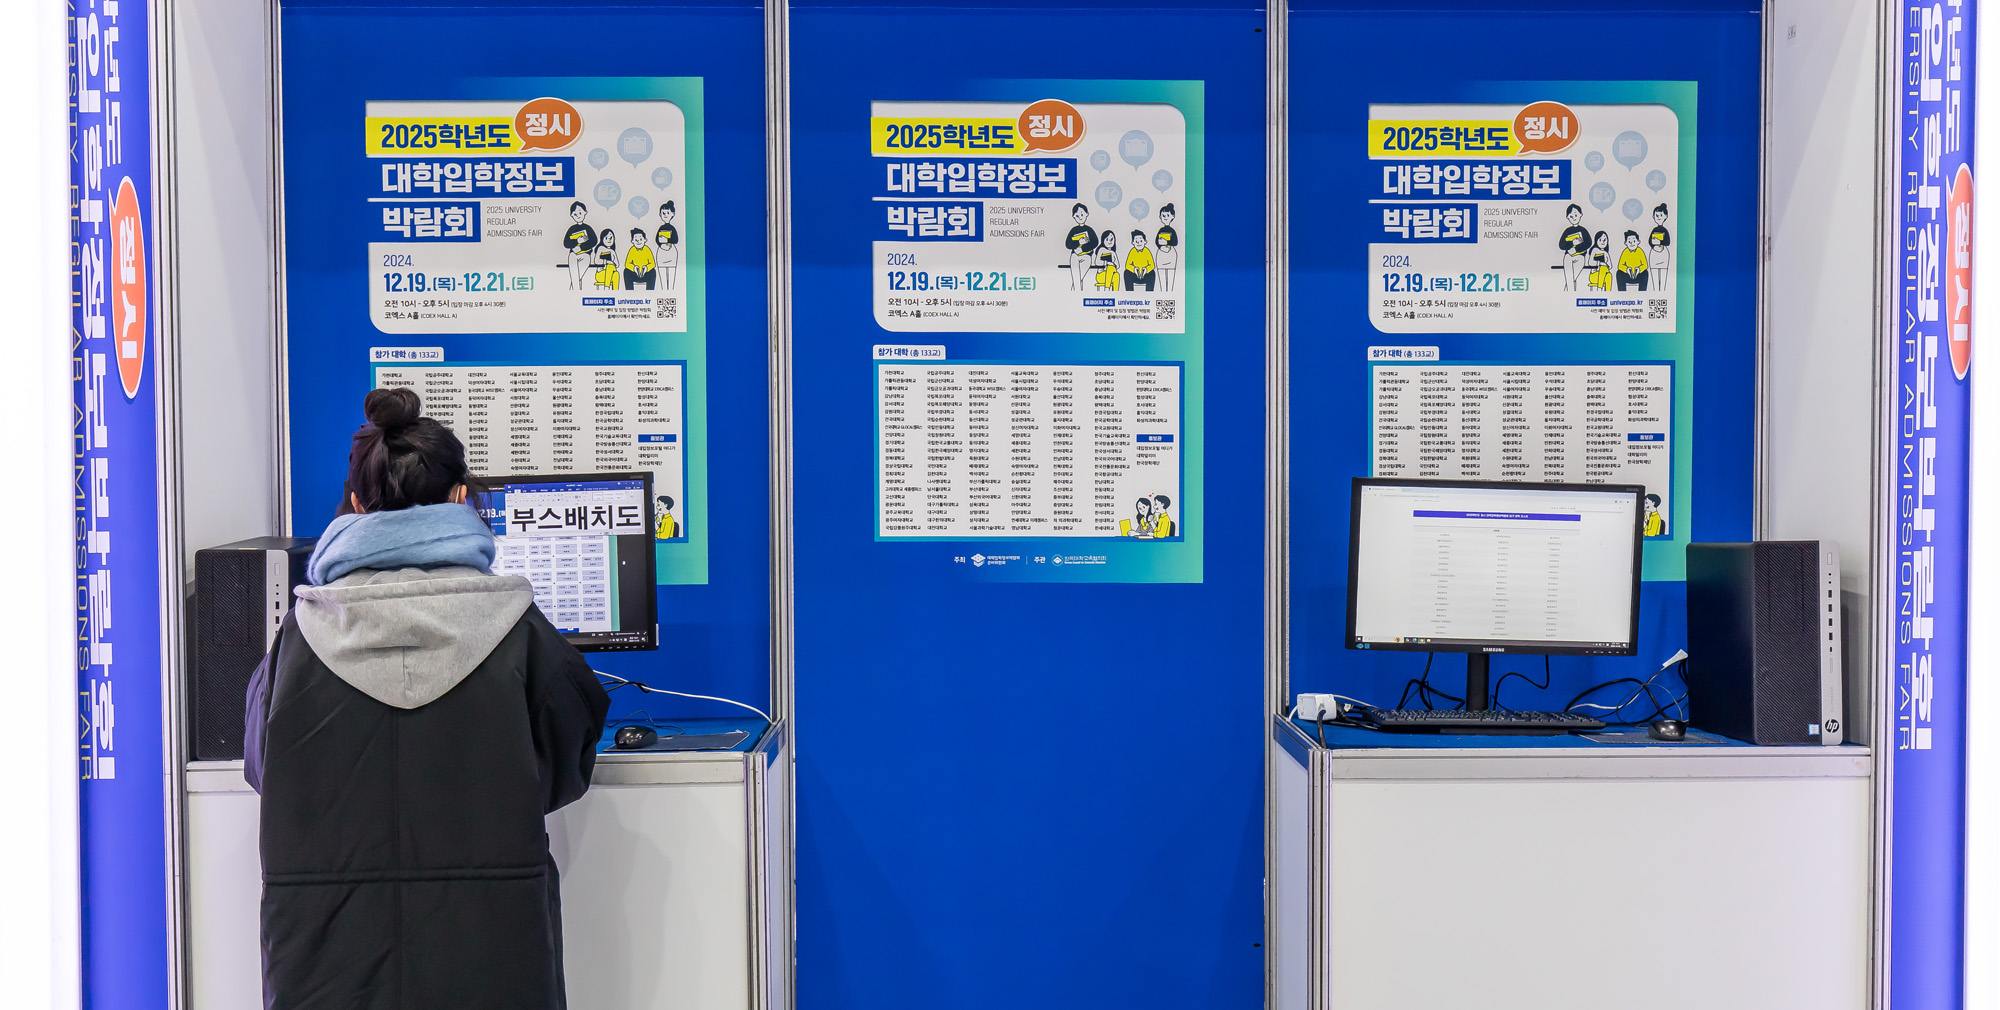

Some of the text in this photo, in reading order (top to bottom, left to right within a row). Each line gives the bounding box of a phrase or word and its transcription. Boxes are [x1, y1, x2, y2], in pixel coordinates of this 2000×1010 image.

[68, 0, 79, 164] ERSITY
[1908, 0, 1921, 151] ERSITY
[526, 113, 570, 136] 정시
[1029, 115, 1073, 137] 정시
[1524, 117, 1568, 139] 정시
[382, 124, 510, 148] 2025학년도
[887, 124, 1014, 148] 2025학년도
[1384, 127, 1509, 150] 2025학년도
[382, 162, 564, 193] 대학입학정보
[887, 163, 1066, 193] 대학입학정보
[1384, 165, 1560, 195] 대학입학정보
[487, 206, 542, 214] 2025 UNIVERSITY
[989, 206, 1044, 214] 2025 UNIVERSITY
[1484, 208, 1538, 216] 2025 UNIVERSITY
[383, 207, 473, 237] 박람회
[487, 218, 516, 226] REGULAR
[888, 206, 975, 236] 박람회
[989, 218, 1019, 226] REGULAR
[1384, 208, 1470, 238] 박람회
[487, 229, 542, 237] ADMISSIONS FAIR
[989, 230, 1045, 238] ADMISSIONS FAIR
[1484, 231, 1538, 239] ADMISSIONS FAIR
[384, 255, 414, 267] 2024.
[888, 253, 917, 265] 2024.
[1383, 255, 1411, 267] 2024.
[1954, 202, 1970, 341] 정시
[120, 216, 138, 359] 정시
[384, 300, 398, 308] 오전
[400, 300, 416, 308] 10시
[422, 300, 436, 308] 오후
[438, 300, 450, 308] 5시
[888, 298, 902, 306] 오전
[904, 298, 919, 306] 10시
[925, 298, 939, 306] 오후
[940, 298, 952, 306] 5시
[1383, 299, 1396, 307] 오전
[1398, 299, 1413, 307] 10시
[1419, 299, 1433, 307] 오후
[1435, 299, 1446, 307] 5시
[888, 310, 908, 318] 코엑스
[910, 310, 921, 318] A홀
[1383, 311, 1403, 319] 코엑스
[1404, 311, 1415, 319] A홀
[375, 350, 439, 359] 참가 대학 (총 133교)
[878, 348, 941, 357] 참가 대학 (총 133교)
[1373, 349, 1434, 358] 참가 대학 (총 133교)
[1899, 171, 1918, 751] REGULAR ADMISSIONS FAIR
[511, 505, 641, 532] 부스배치도
[73, 403, 90, 671] ADMISSIONS
[1033, 556, 1046, 564] 주관
[1825, 719, 1840, 733] hp
[79, 692, 91, 780] FAIR
